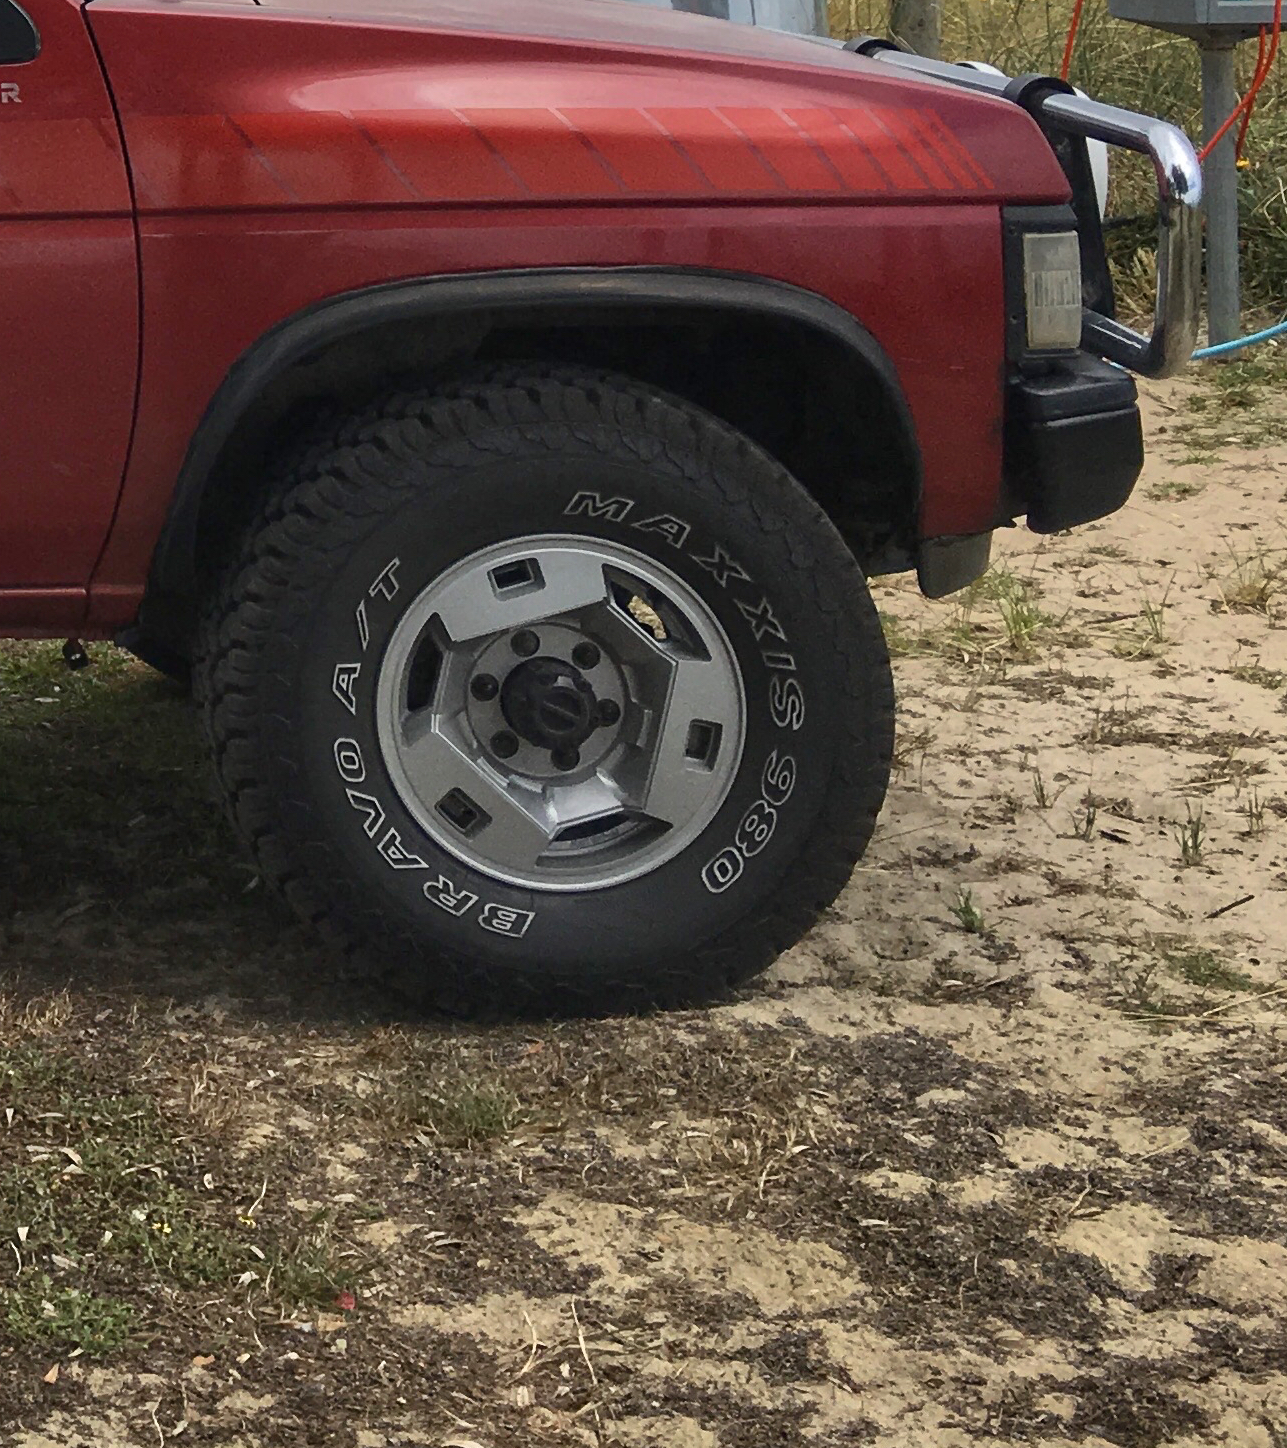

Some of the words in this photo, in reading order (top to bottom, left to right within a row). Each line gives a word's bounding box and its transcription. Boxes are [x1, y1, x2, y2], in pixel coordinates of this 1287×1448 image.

[333, 557, 400, 714] A/T
[564, 492, 804, 730] MAXXIS
[701, 750, 795, 893] 980
[334, 738, 536, 937] BRAVO
